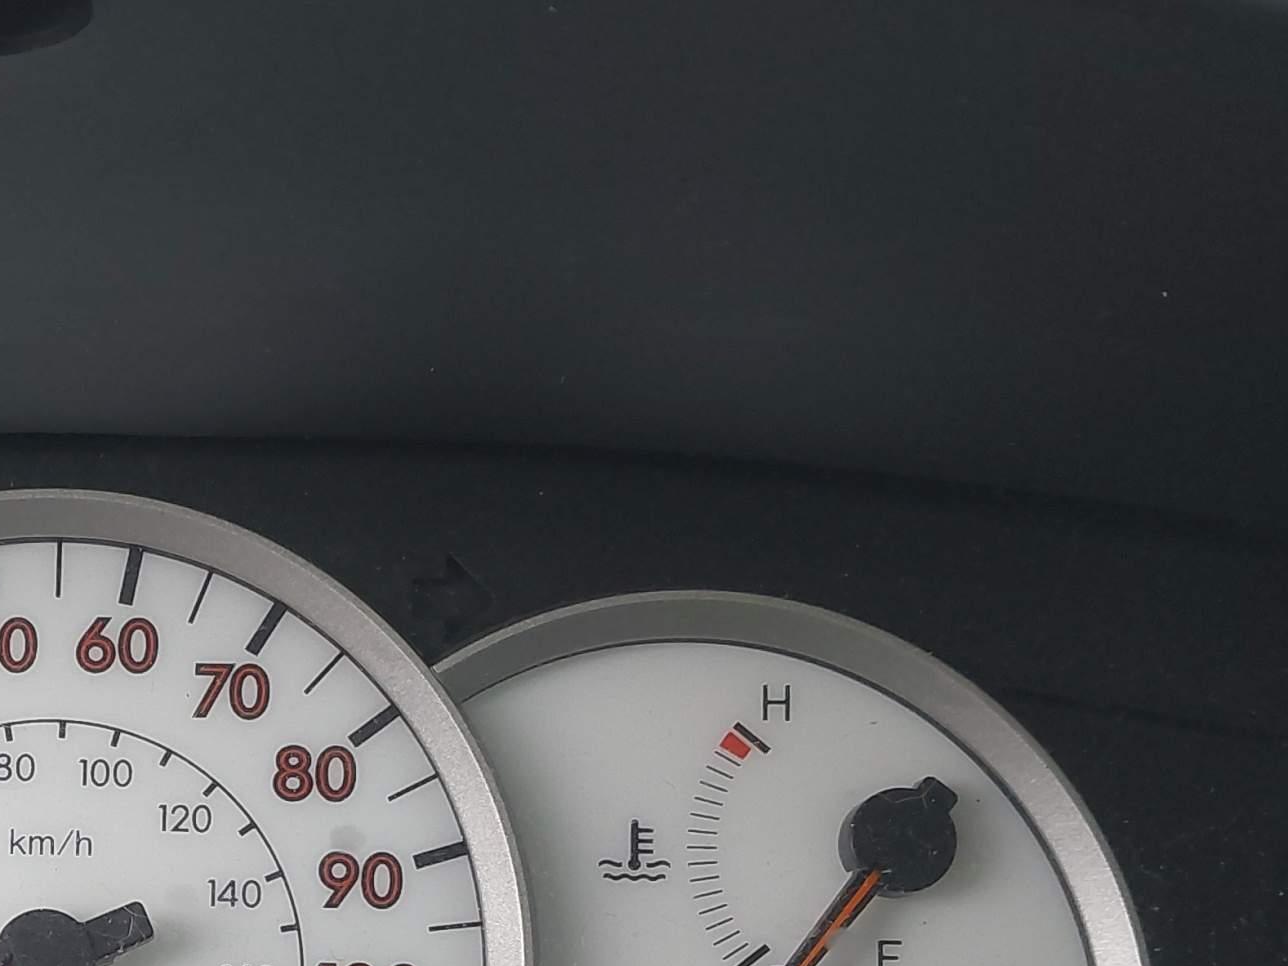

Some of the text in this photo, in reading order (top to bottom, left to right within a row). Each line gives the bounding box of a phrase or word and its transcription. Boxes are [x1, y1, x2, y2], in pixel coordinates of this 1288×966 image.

[76, 617, 159, 674] 60
[192, 663, 270, 720] 70
[763, 685, 790, 721] H
[79, 759, 132, 787] 100
[273, 745, 357, 802] 80
[158, 804, 212, 833] 120
[10, 829, 92, 856] km/h
[208, 879, 261, 908] 140
[319, 851, 403, 909] 90
